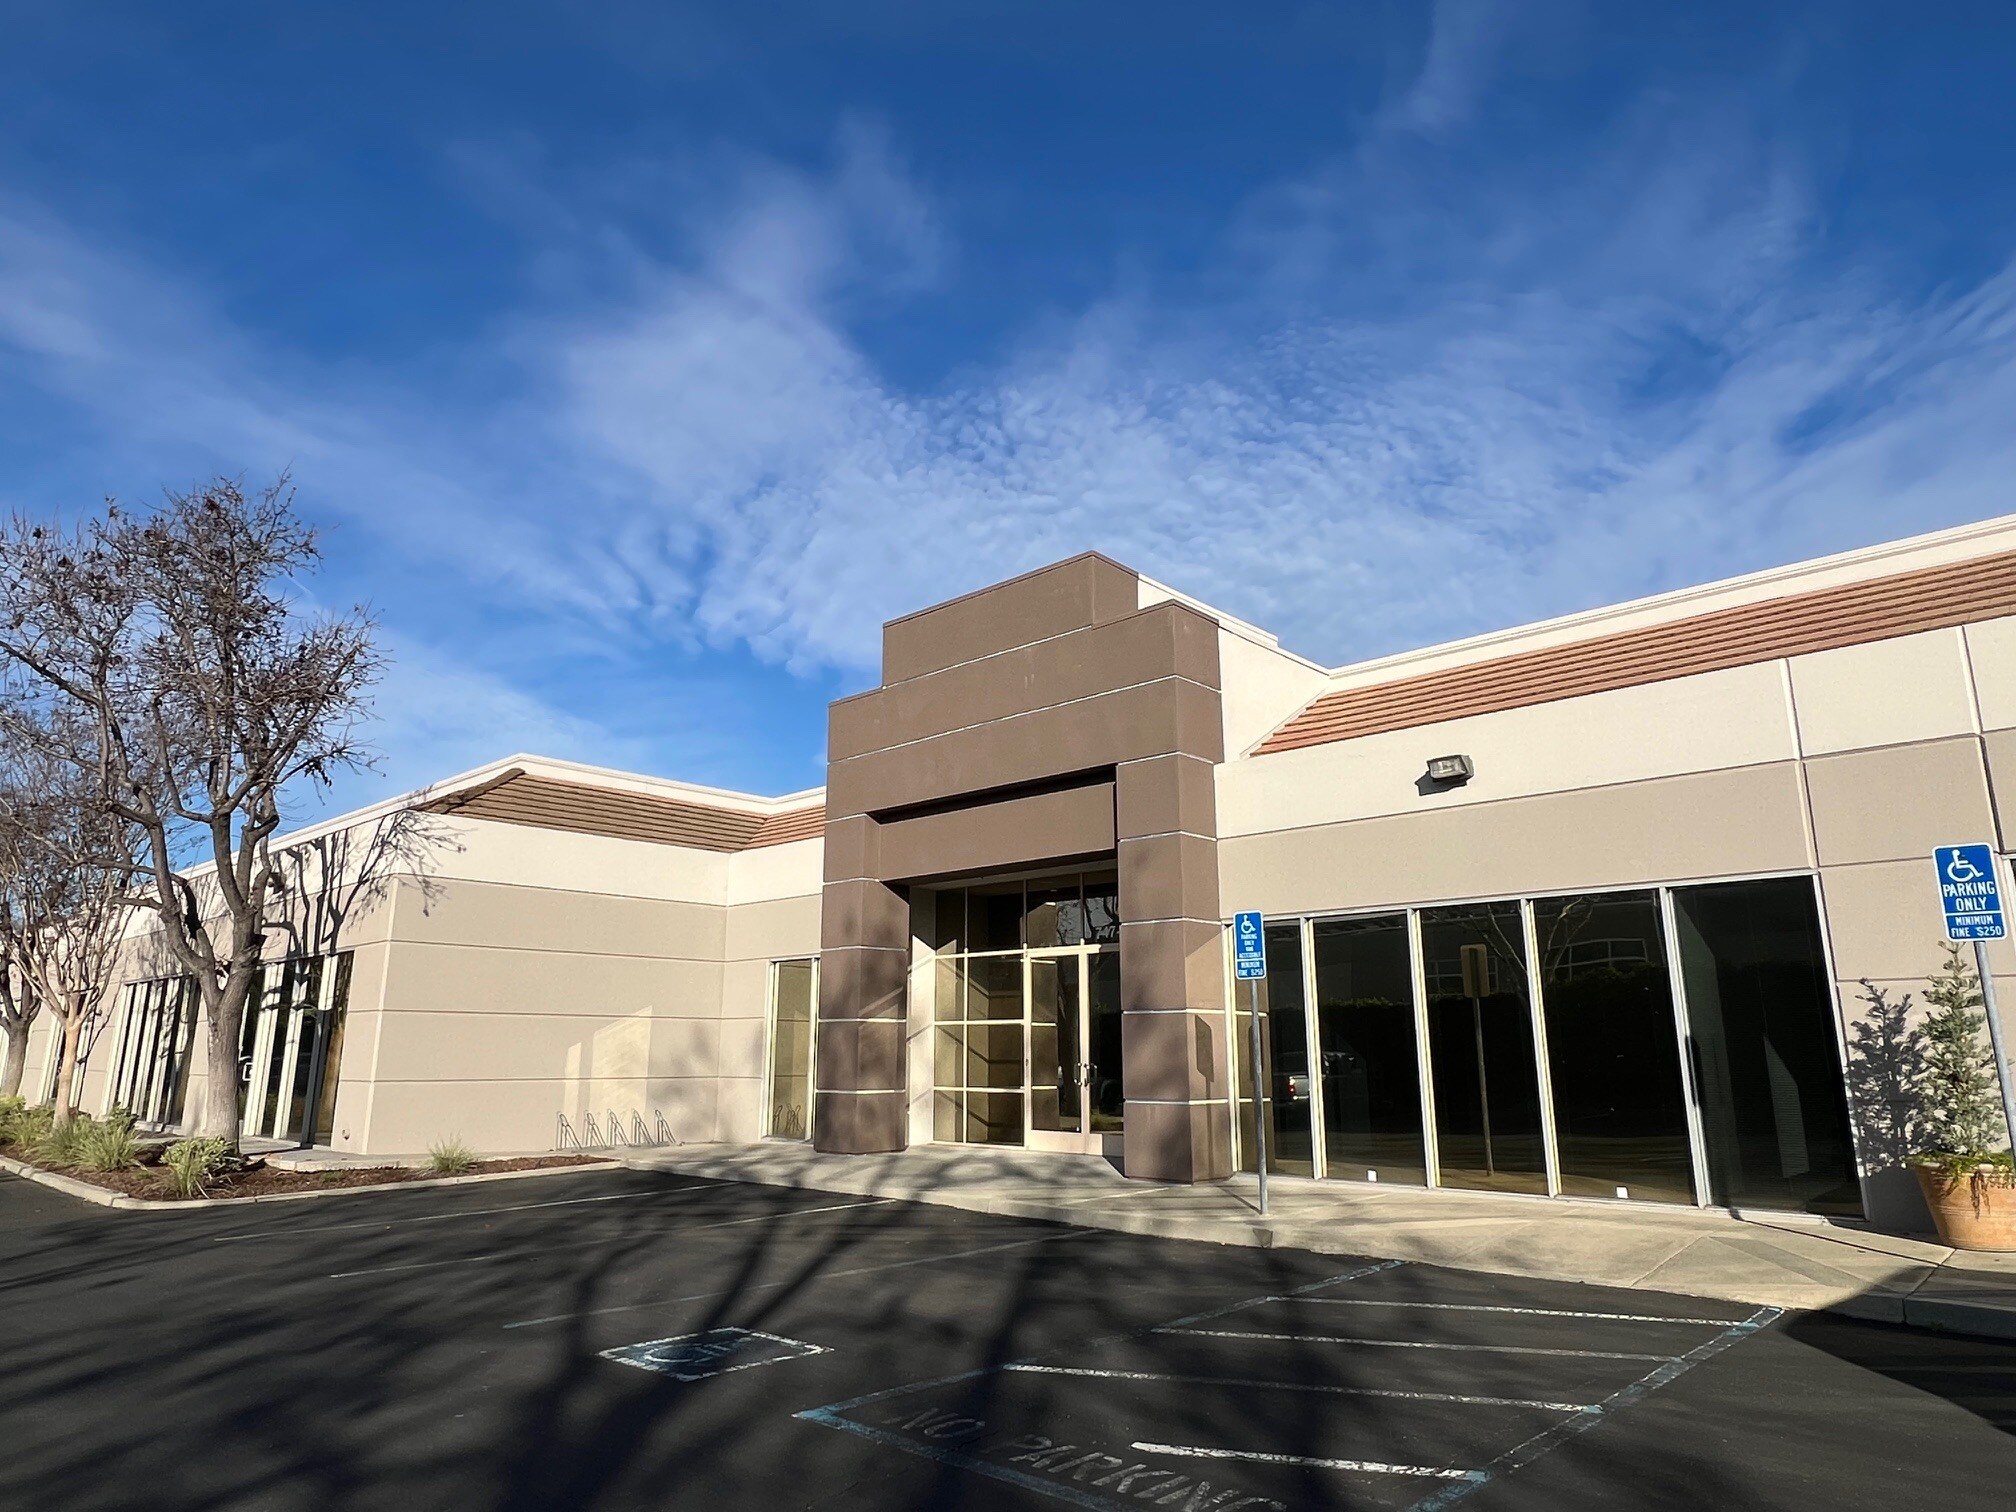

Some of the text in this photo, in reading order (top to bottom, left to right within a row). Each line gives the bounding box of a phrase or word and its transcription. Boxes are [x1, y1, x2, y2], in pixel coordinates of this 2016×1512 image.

[1943, 881, 1995, 897] PARKING
[1956, 898, 1987, 911] ONLY
[1956, 915, 1994, 925] MINIMUM
[1951, 926, 2002, 937] FINE $250
